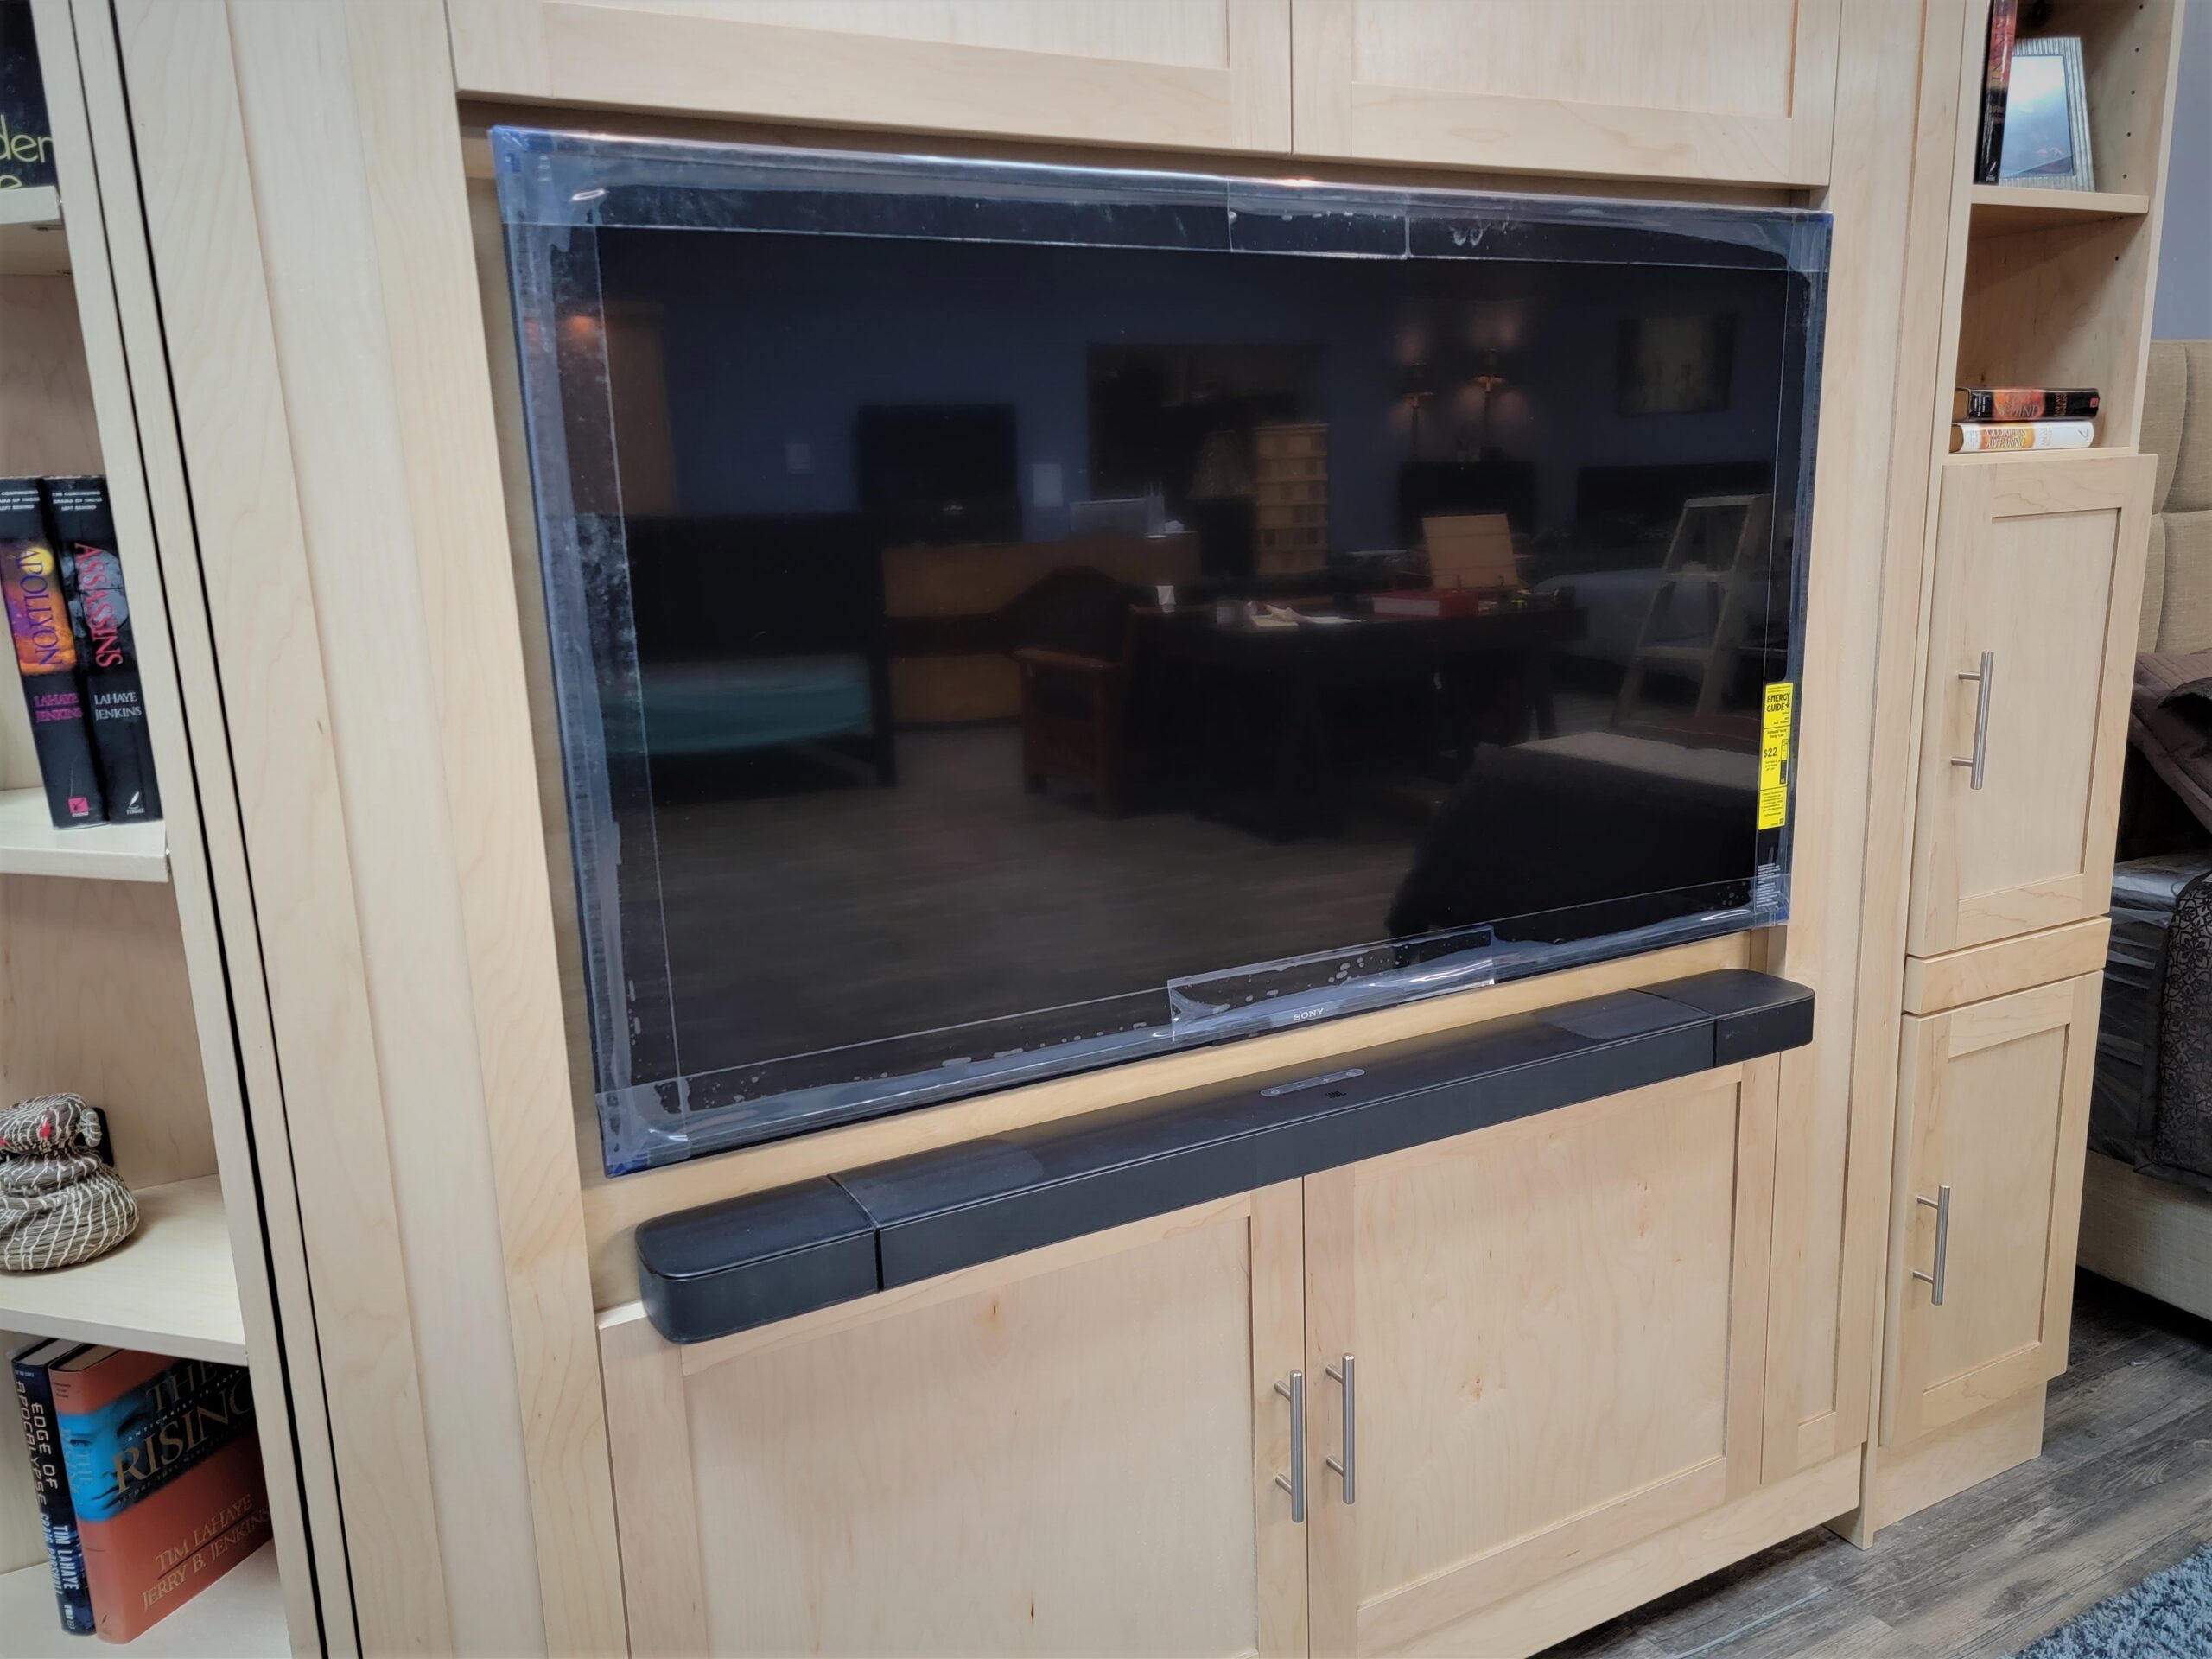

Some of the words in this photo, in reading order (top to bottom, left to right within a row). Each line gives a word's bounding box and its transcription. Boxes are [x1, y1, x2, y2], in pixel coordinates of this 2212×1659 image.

[15, 544, 63, 665] APOLLYON
[74, 543, 124, 668] ASSASSINS
[95, 706, 142, 721] JENKINS
[1766, 702, 1785, 713] GUIDE
[1764, 747, 1777, 758] $22
[1294, 1007, 1325, 1021] SONY
[16, 1380, 48, 1506] APOCALYPSE
[31, 1402, 51, 1455] EDGE
[43, 1464, 59, 1490] OF
[41, 1513, 54, 1545] CRAIG
[53, 1525, 71, 1545] TIM
[142, 1565, 188, 1611] JERRY
[192, 1553, 207, 1573] B.
[210, 1506, 271, 1563] JENKINS
[155, 1538, 190, 1572] TIM
